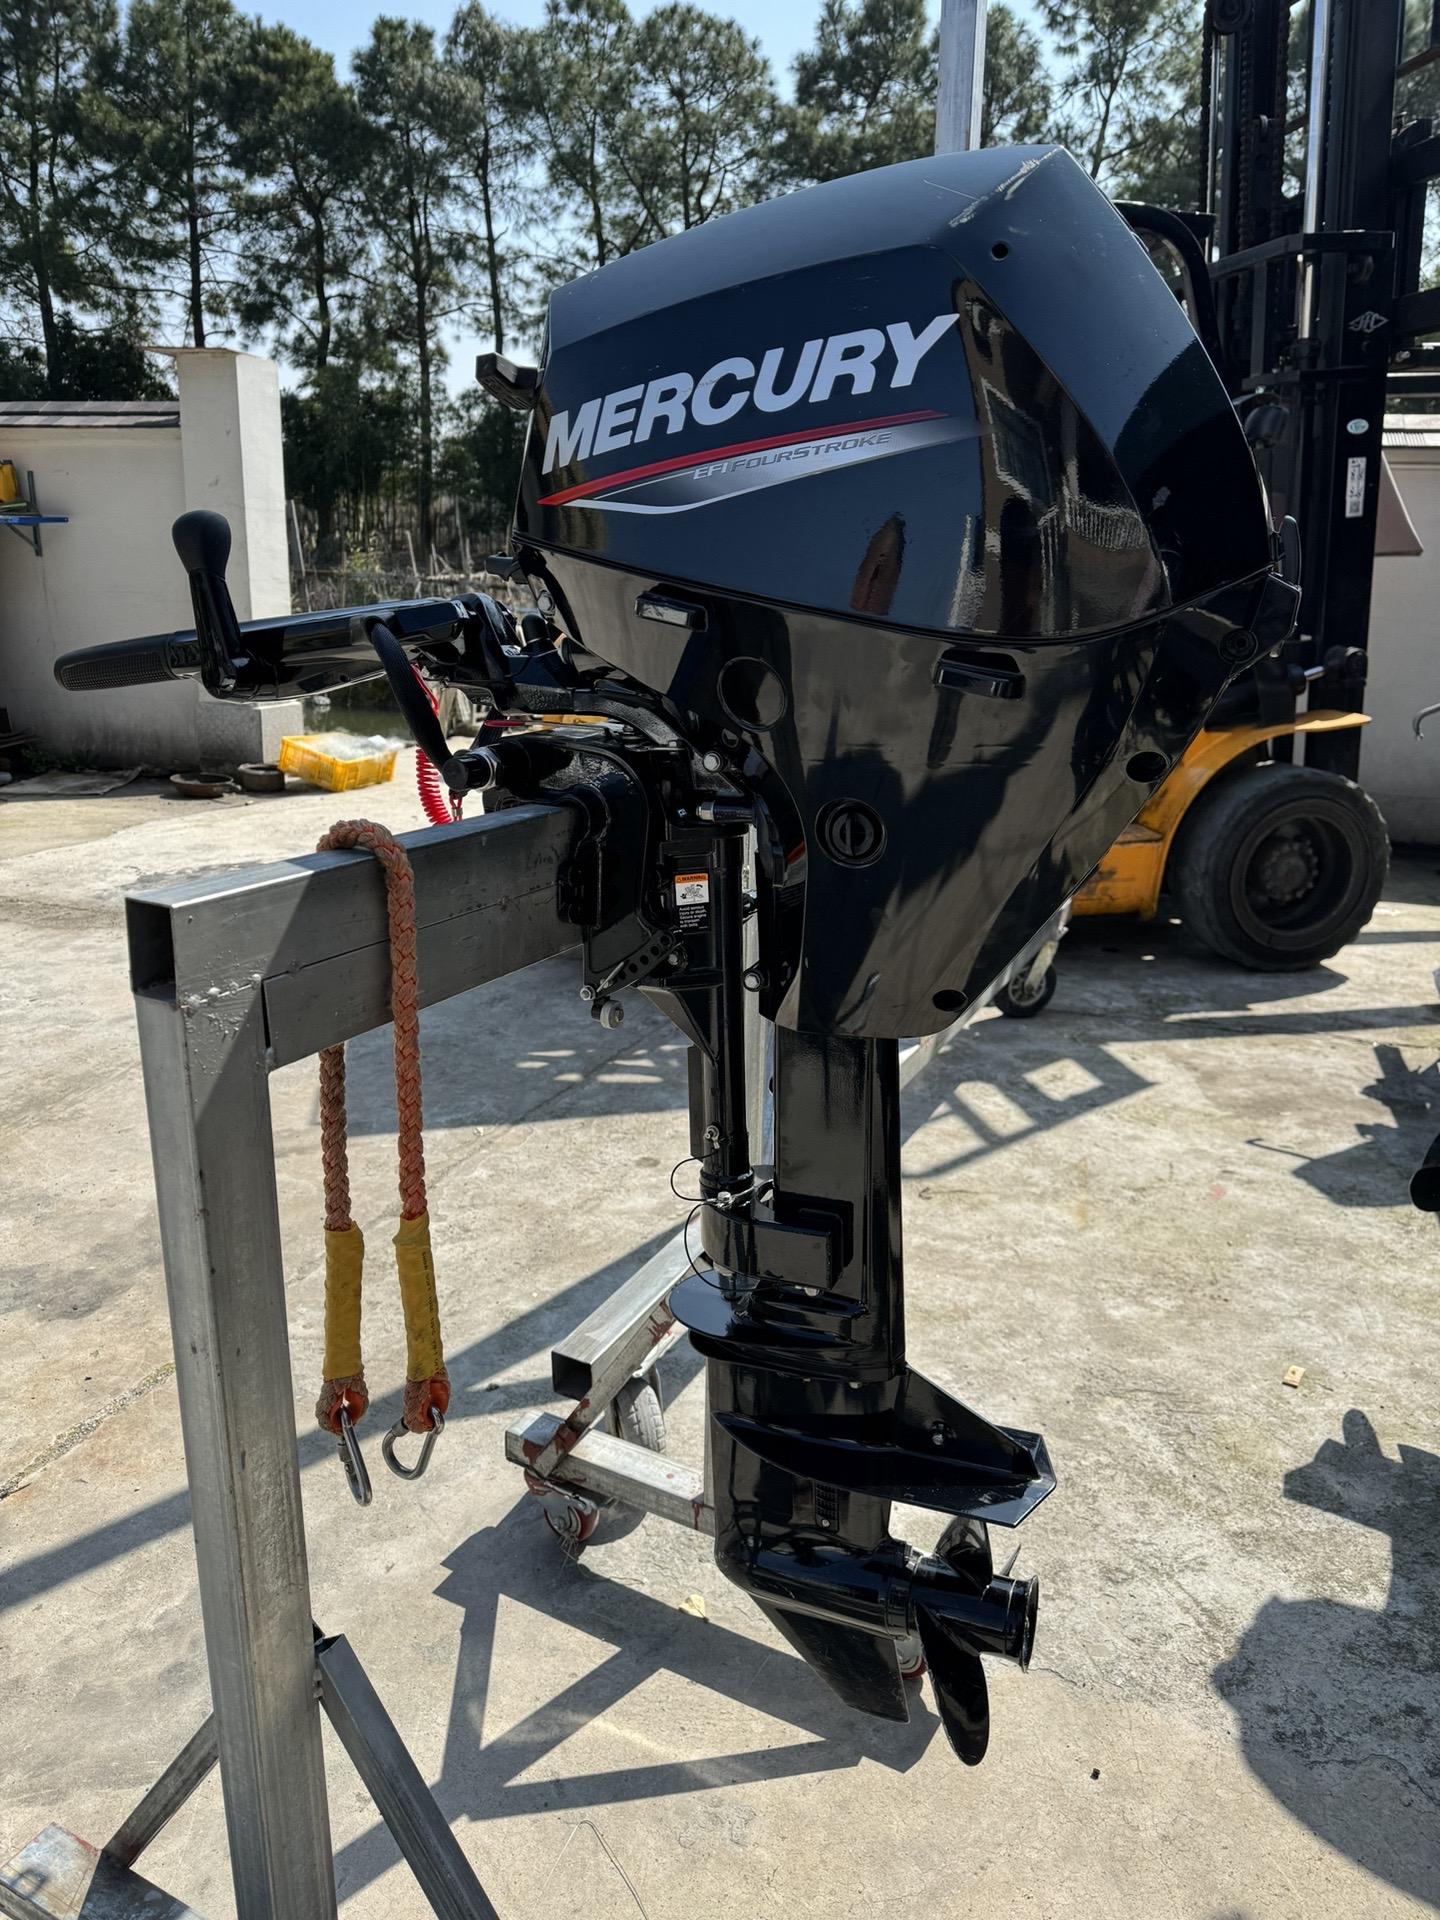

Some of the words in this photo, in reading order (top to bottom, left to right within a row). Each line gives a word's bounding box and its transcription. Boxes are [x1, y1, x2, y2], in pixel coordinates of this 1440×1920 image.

[541, 313, 960, 475] MERCURY
[693, 462, 729, 479] EFI
[730, 432, 893, 473] FOURSTROKE
